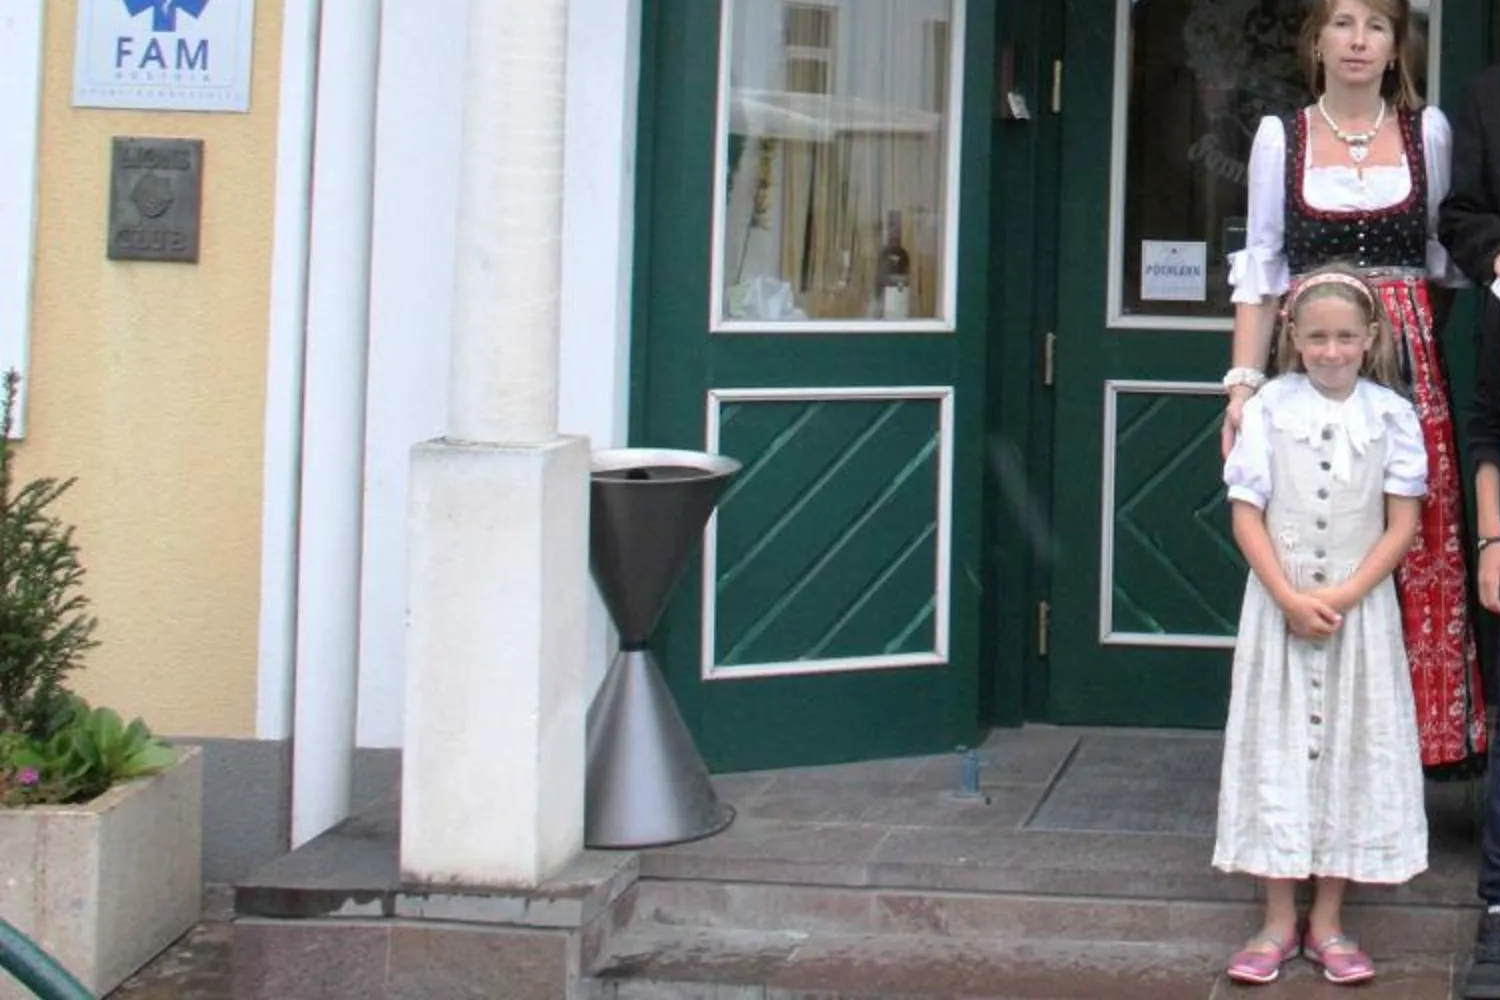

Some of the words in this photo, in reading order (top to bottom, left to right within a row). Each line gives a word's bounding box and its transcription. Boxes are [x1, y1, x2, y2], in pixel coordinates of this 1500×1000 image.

[114, 35, 210, 71] FAM
[120, 147, 191, 171] LIONS
[115, 229, 188, 252] CLUB
